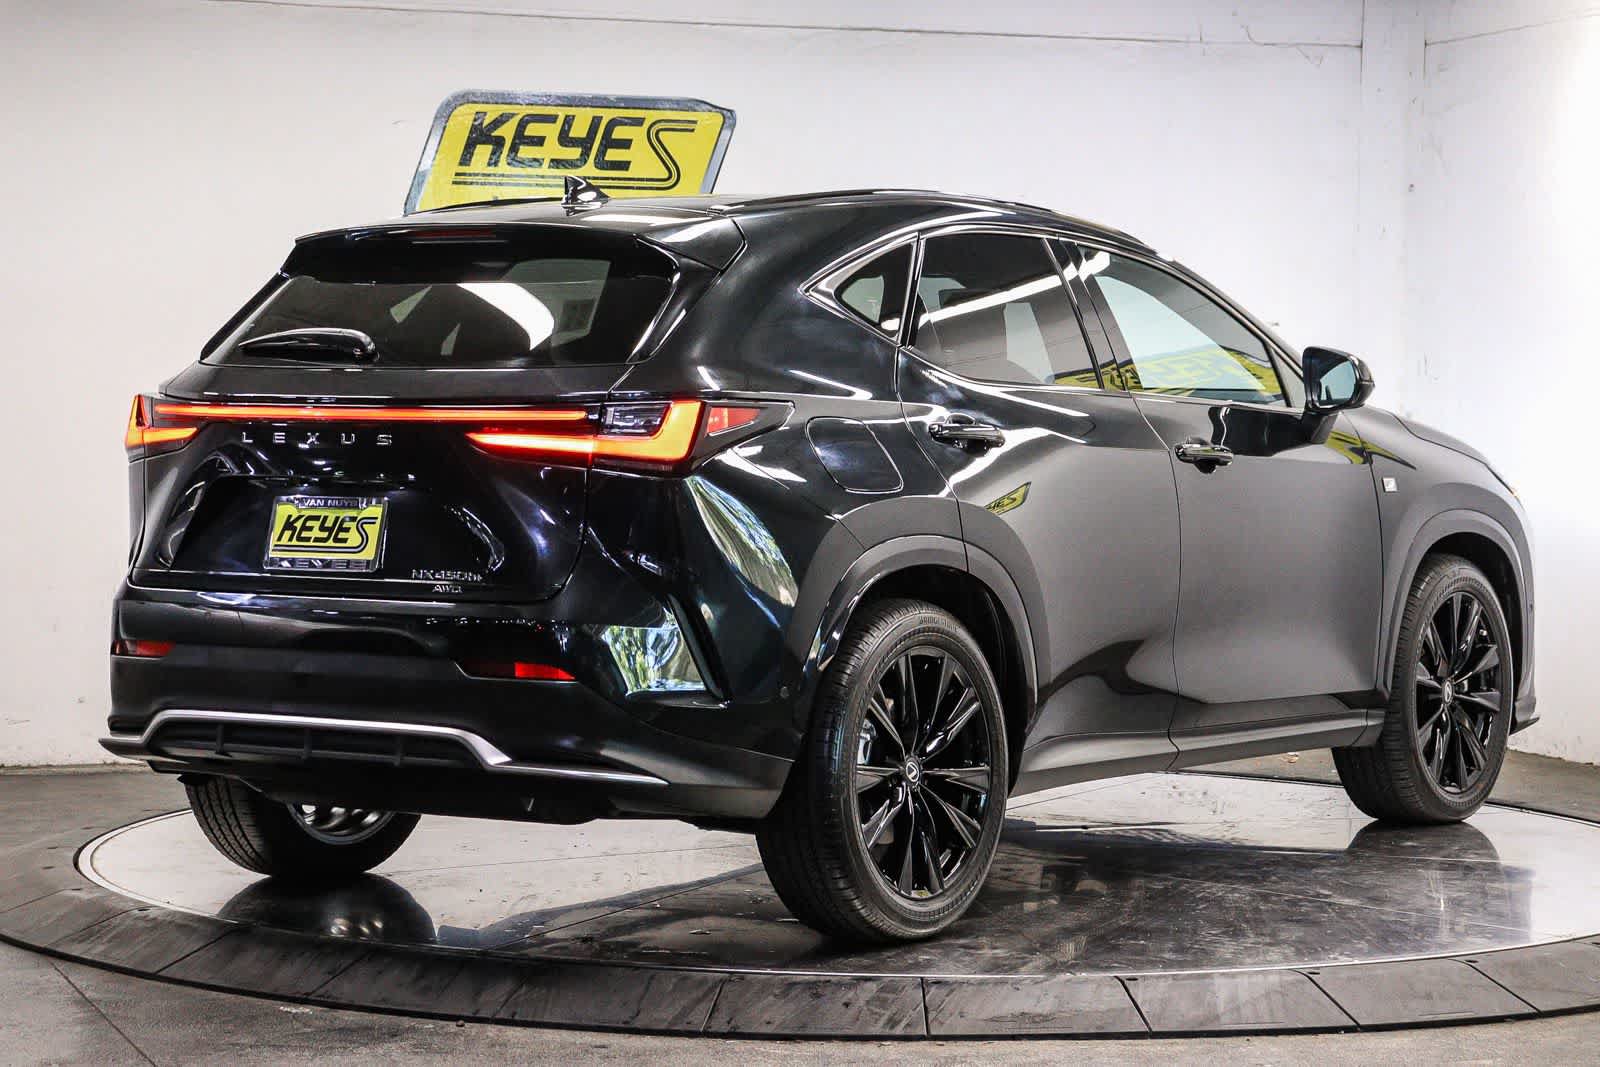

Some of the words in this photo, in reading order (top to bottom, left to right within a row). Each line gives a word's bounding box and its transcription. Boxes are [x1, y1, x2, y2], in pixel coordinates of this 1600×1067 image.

[453, 112, 698, 191] KEYES
[242, 432, 392, 446] LEXUS
[304, 498, 325, 507] VAN
[273, 514, 379, 554] KEYES
